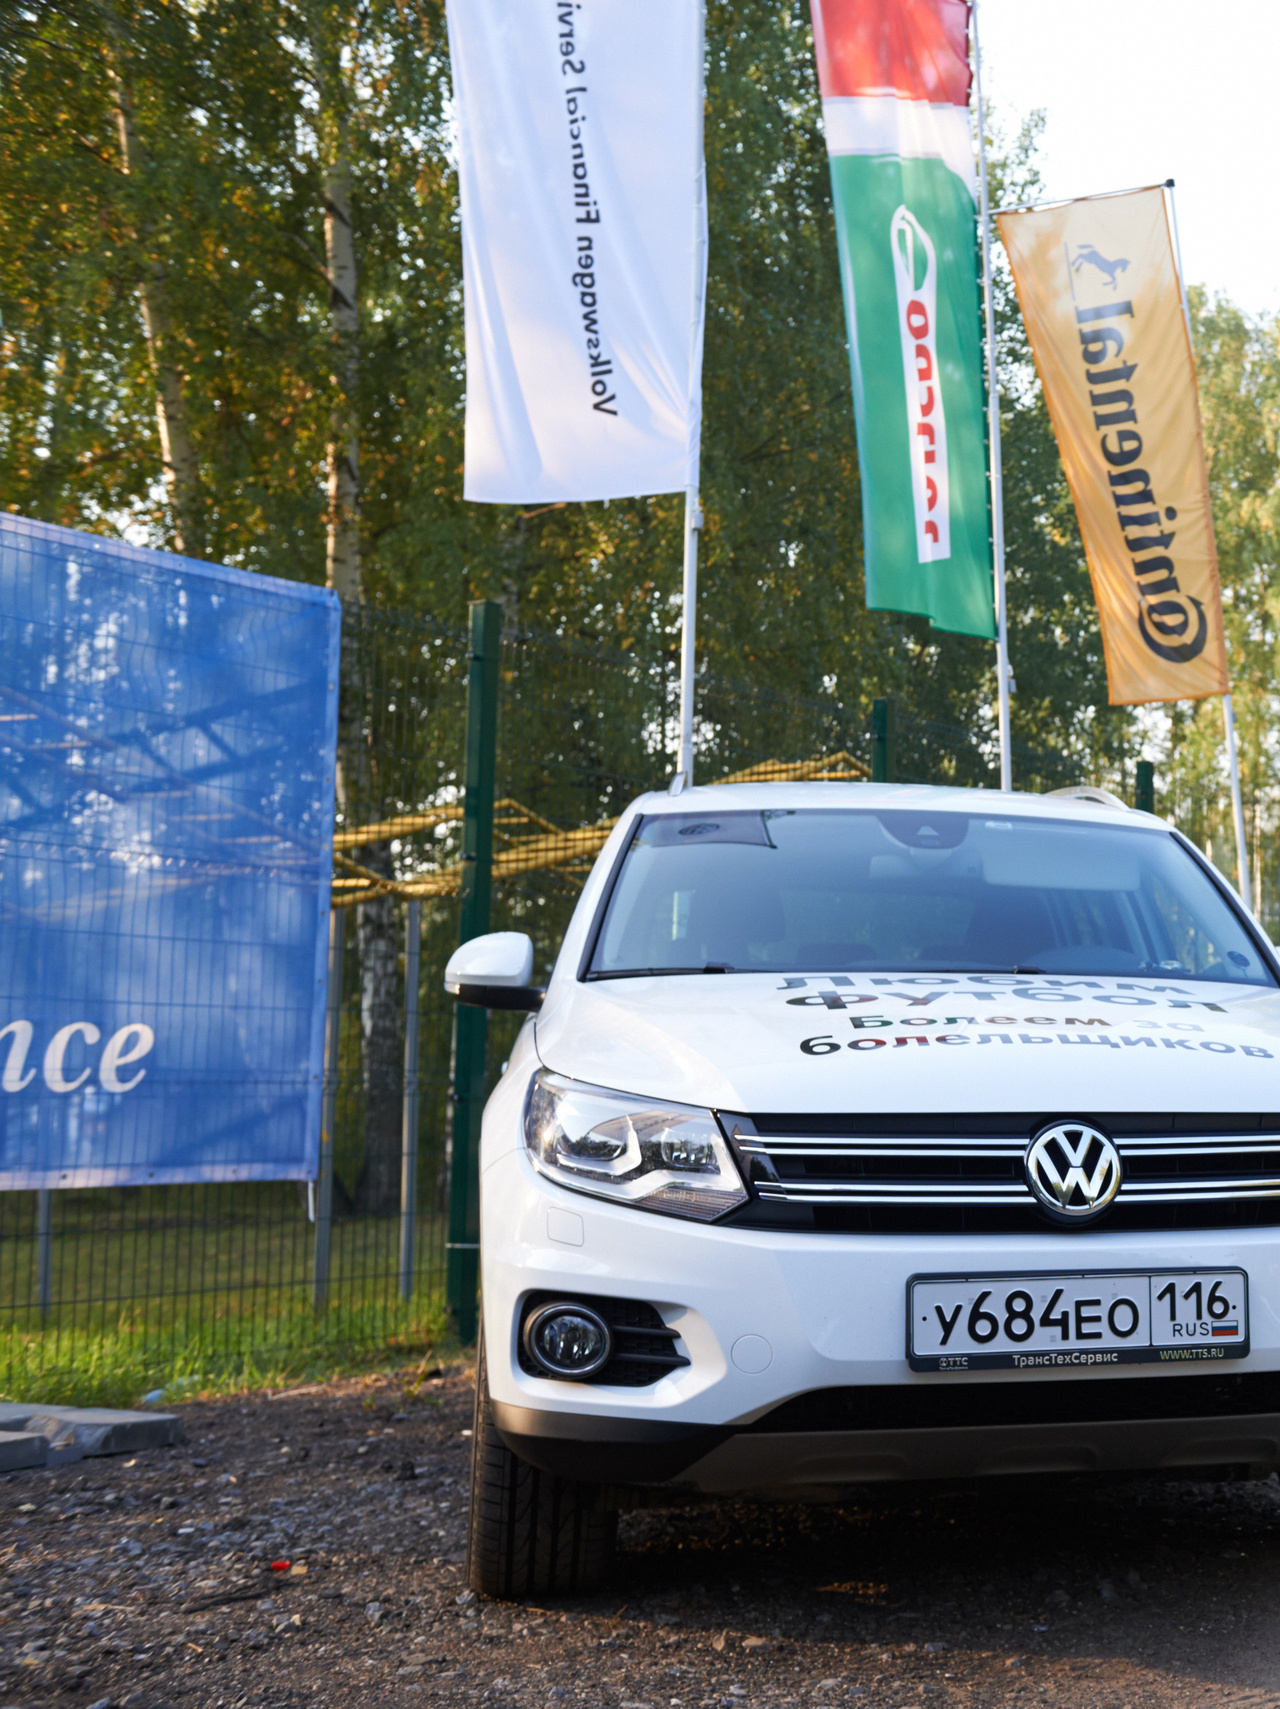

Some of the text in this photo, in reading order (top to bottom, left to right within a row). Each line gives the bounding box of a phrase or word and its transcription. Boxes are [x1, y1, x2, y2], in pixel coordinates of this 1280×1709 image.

[777, 975, 1196, 996] Любим
[786, 987, 1229, 1014] футбол
[849, 1015, 1205, 1033] Болеем за
[799, 1034, 1275, 1059] болельщиков
[1157, 1281, 1230, 1322] 116
[1173, 1322, 1210, 1338] RUS
[1012, 1352, 1119, 1368] ТрансТехСервис
[1160, 1348, 1225, 1360] WWW.TTS.RU
